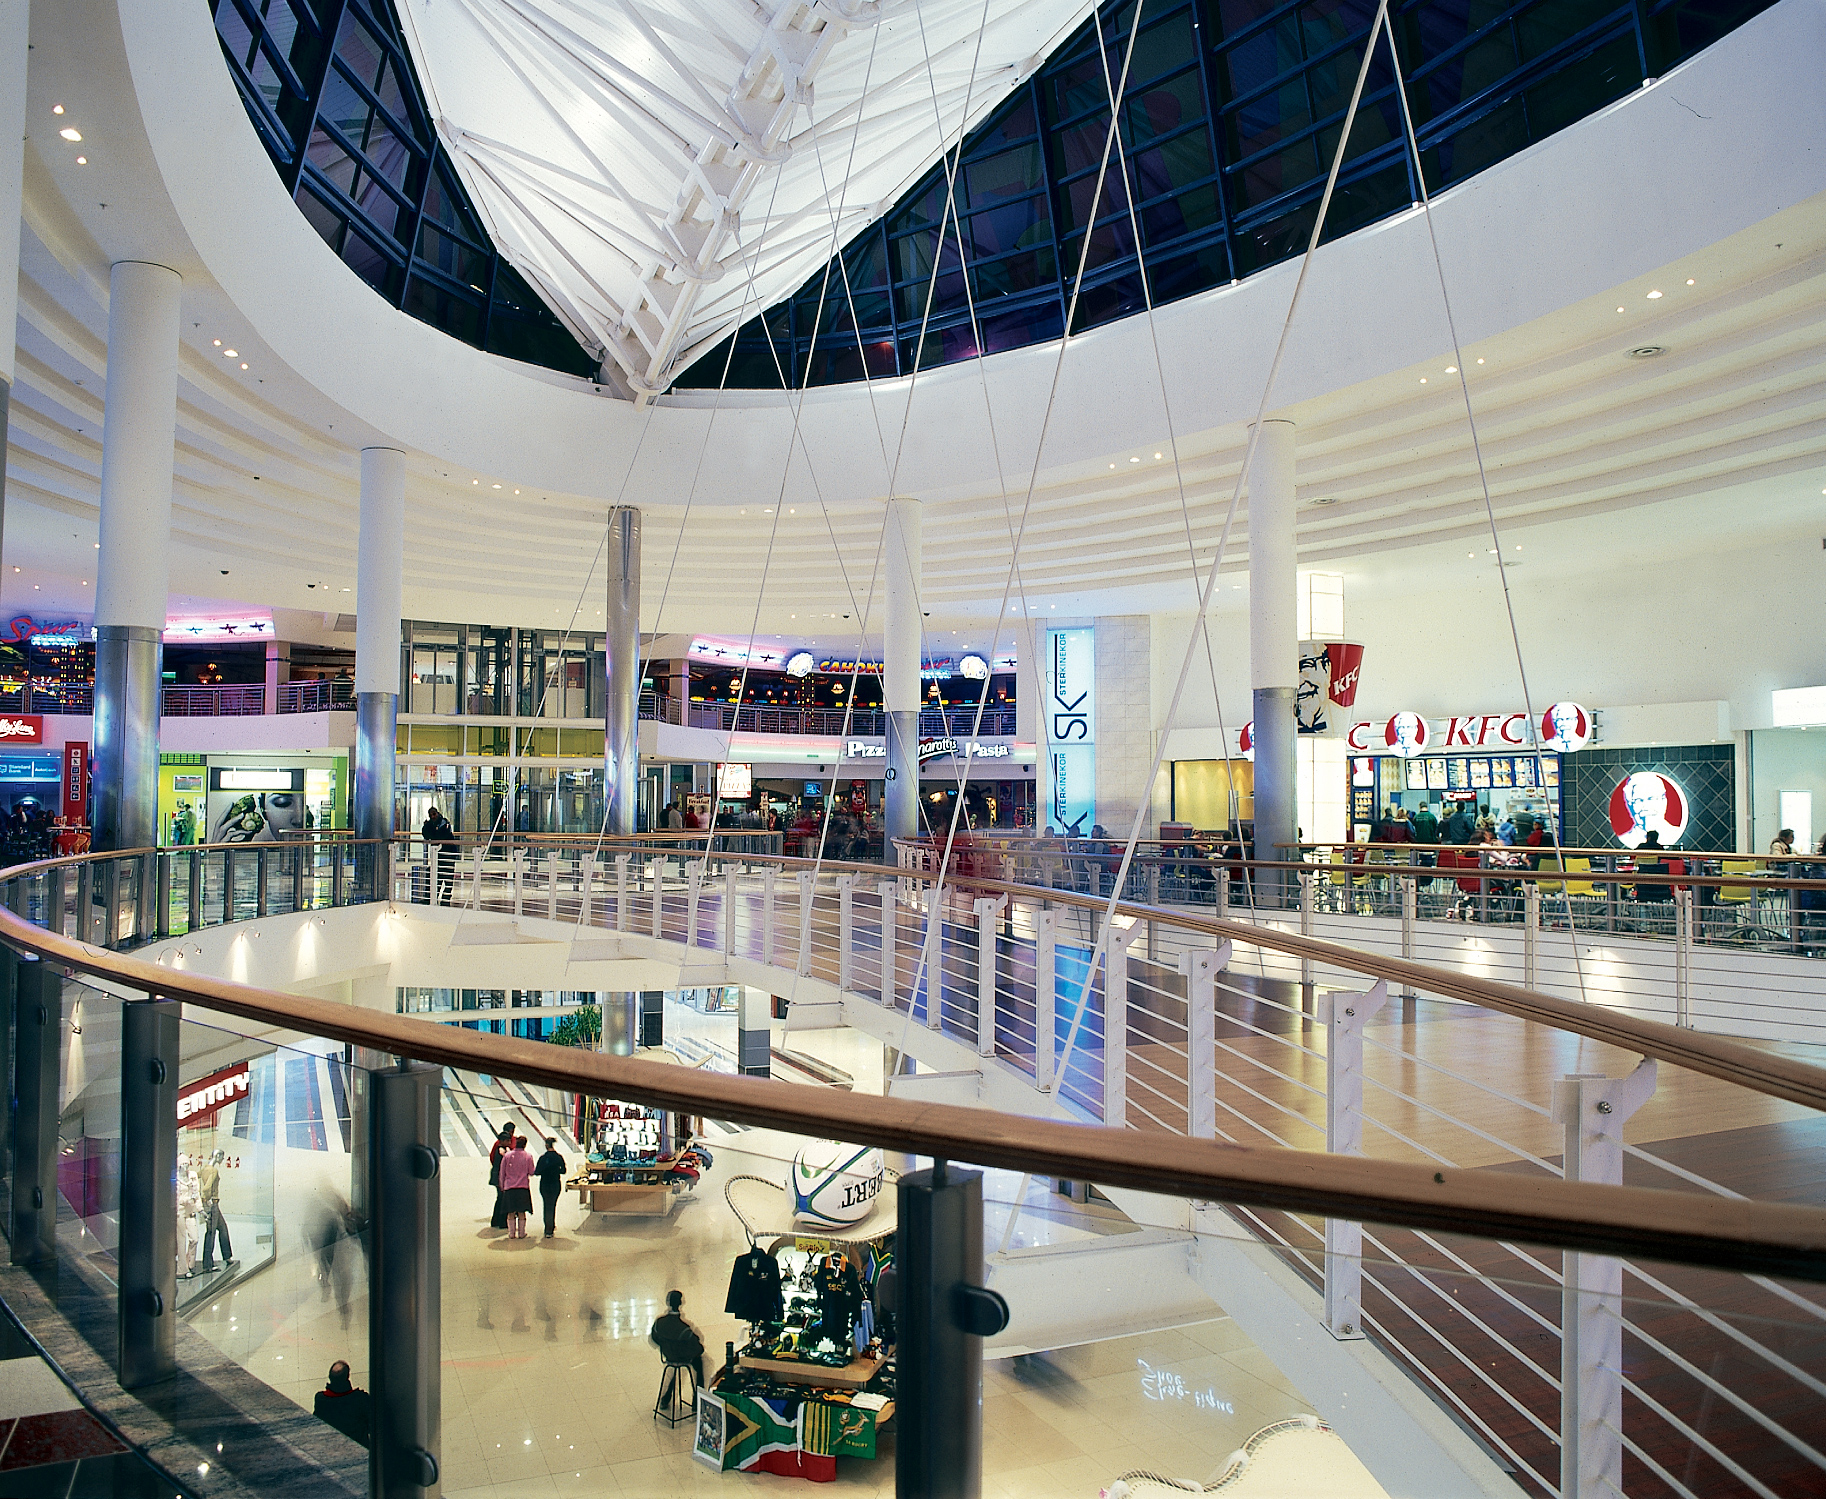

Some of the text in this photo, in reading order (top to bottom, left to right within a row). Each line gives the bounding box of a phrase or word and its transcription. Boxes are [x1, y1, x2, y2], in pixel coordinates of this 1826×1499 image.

[820, 661, 884, 673] CAHOKI
[1333, 665, 1360, 696] KFC
[1445, 713, 1526, 746] KFC
[847, 738, 1009, 758] Pizz narottis Pasta
[177, 1071, 249, 1120] ENTITY
